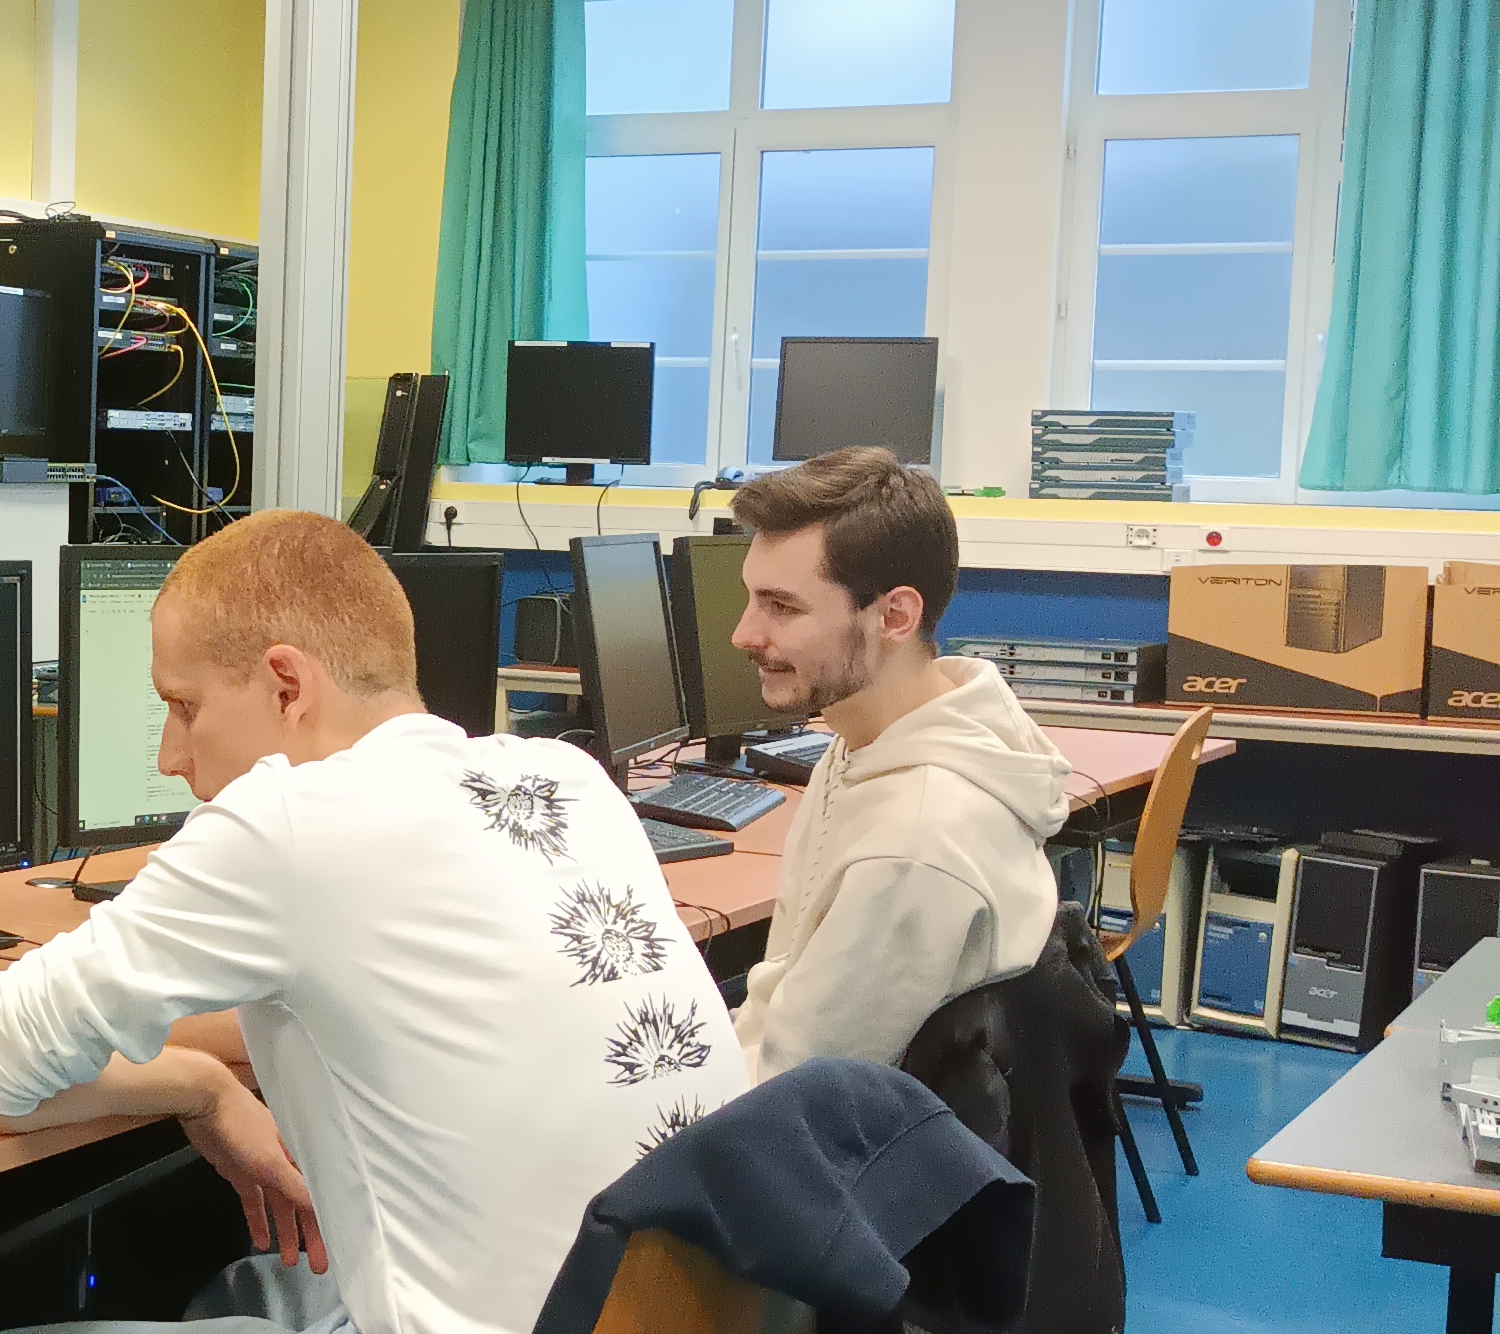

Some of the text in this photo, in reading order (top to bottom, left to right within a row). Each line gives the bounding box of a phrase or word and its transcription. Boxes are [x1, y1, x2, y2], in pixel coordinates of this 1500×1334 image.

[1198, 576, 1282, 586] VERITON
[1182, 675, 1247, 694] acer
[1447, 690, 1500, 708] ace
[1308, 986, 1338, 998] acer
